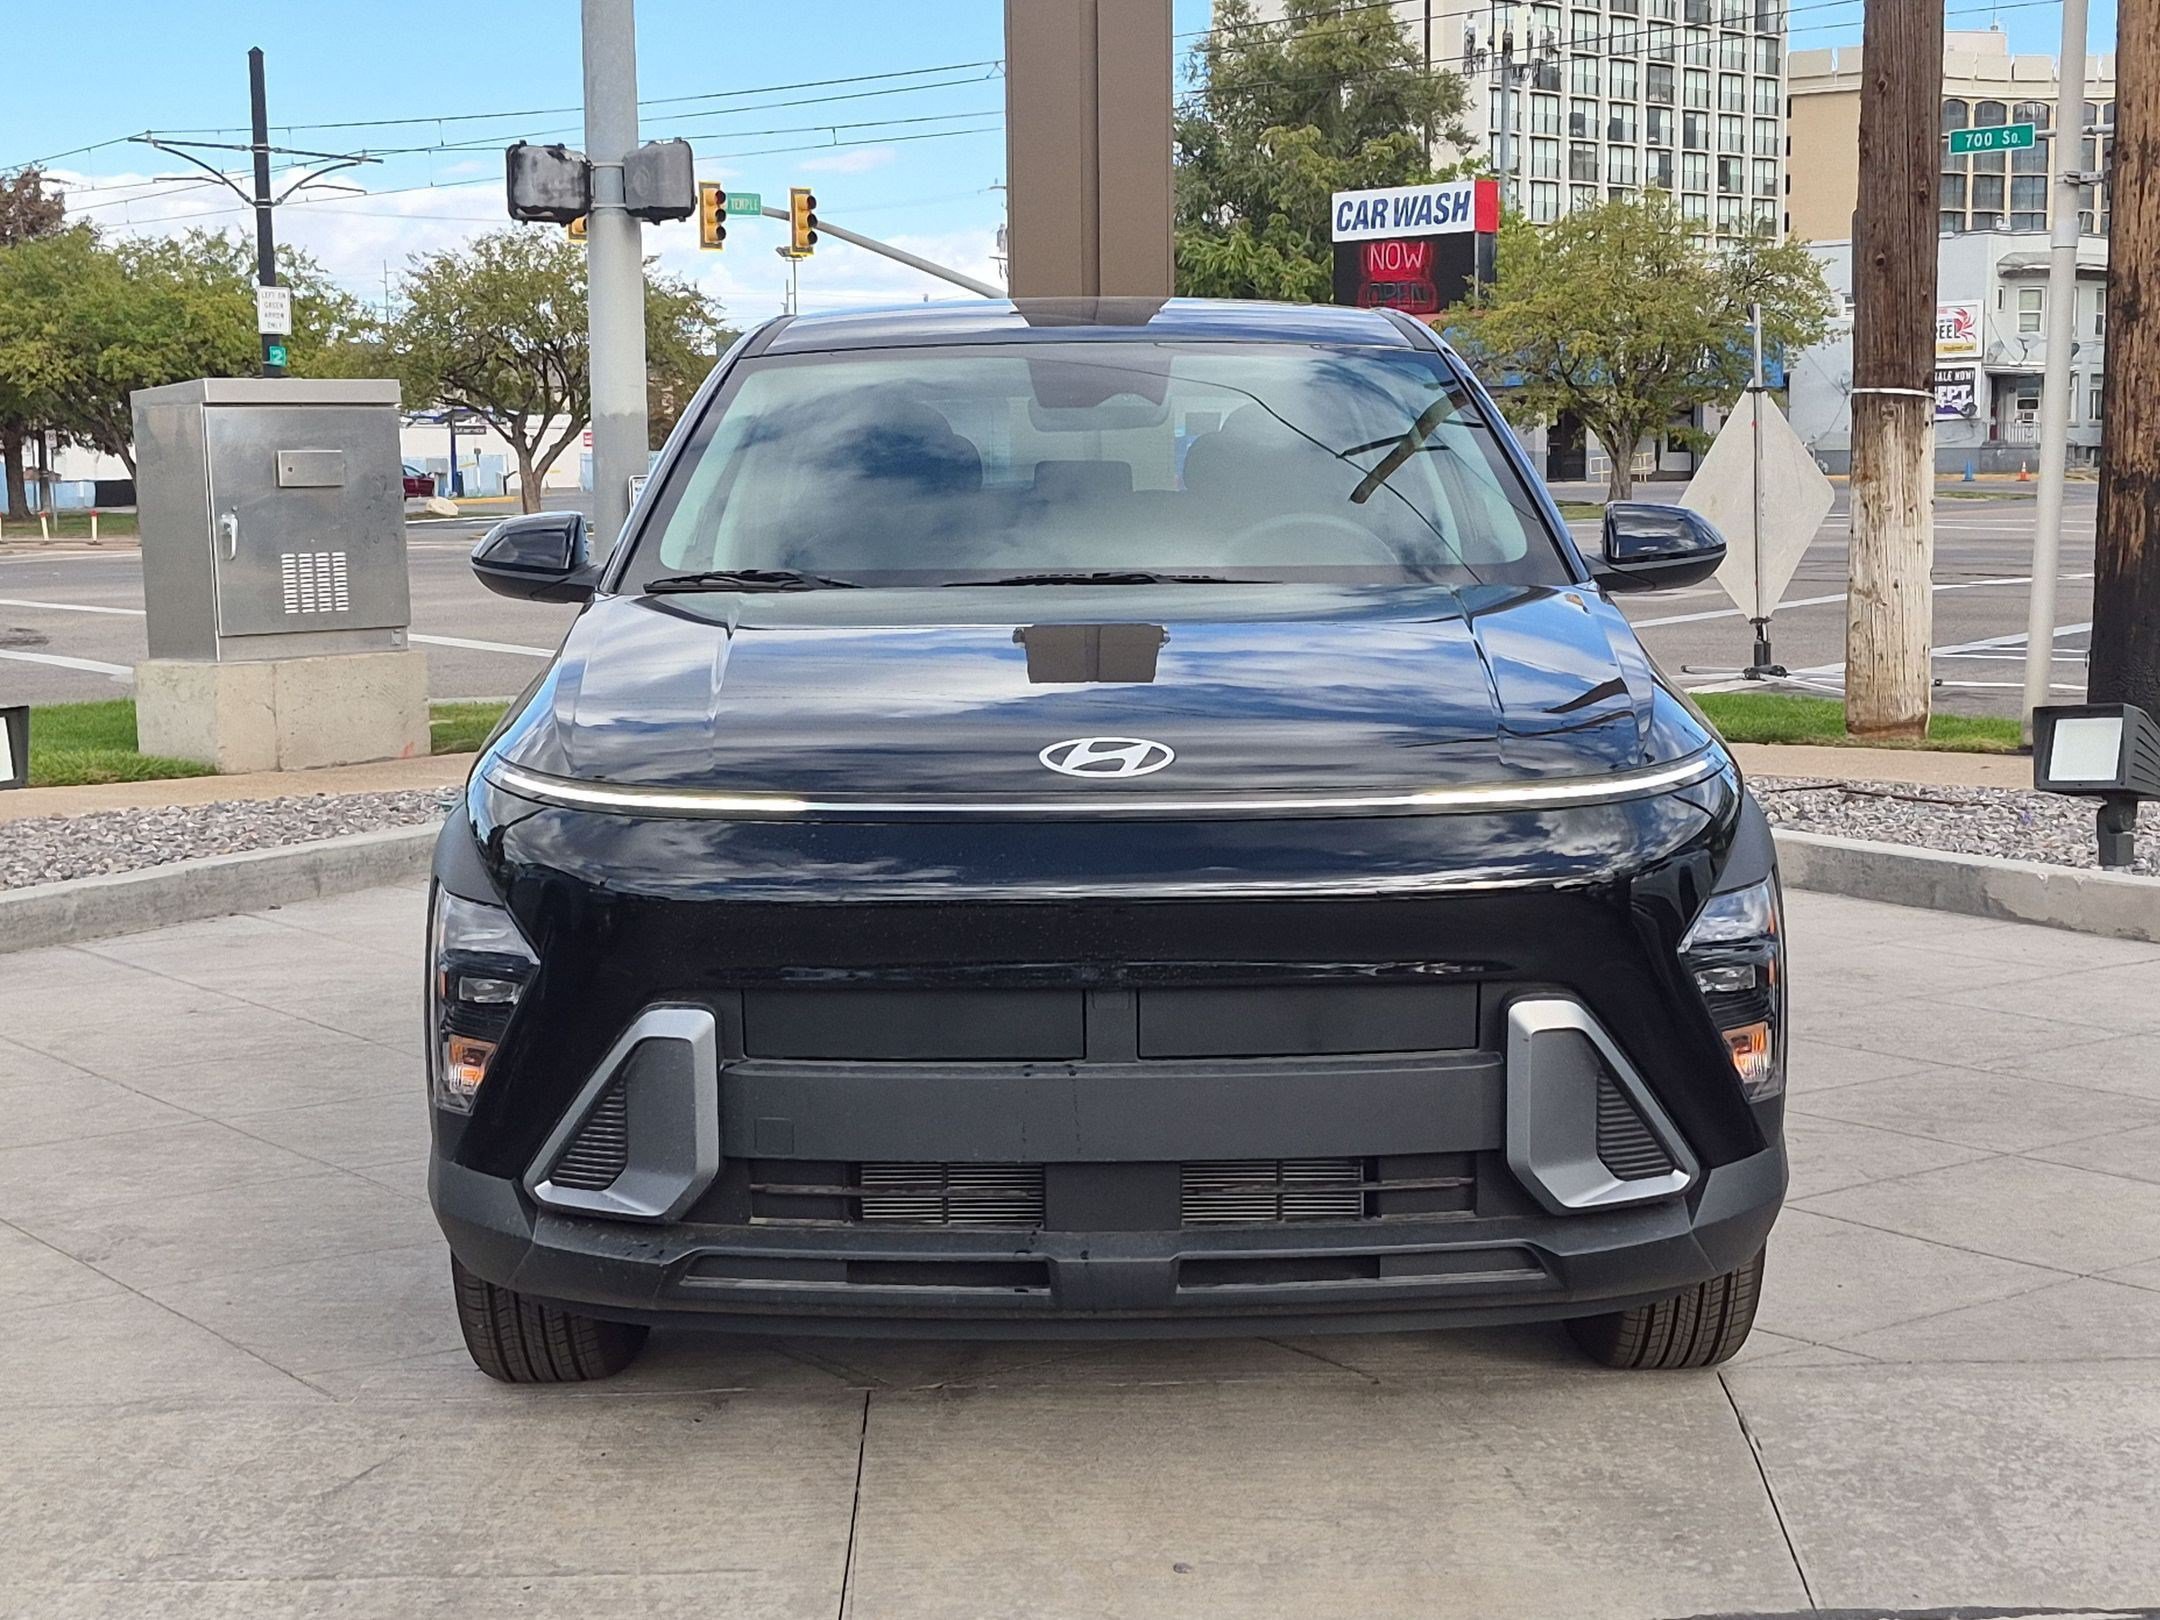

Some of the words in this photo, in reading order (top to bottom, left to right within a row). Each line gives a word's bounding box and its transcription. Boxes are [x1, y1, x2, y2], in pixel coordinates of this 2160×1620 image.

[1965, 132, 1992, 148] 700
[1336, 198, 1389, 232] CAR
[1393, 190, 1472, 228] WASH
[1368, 240, 1425, 272] NOW
[1936, 324, 1961, 339] EEL
